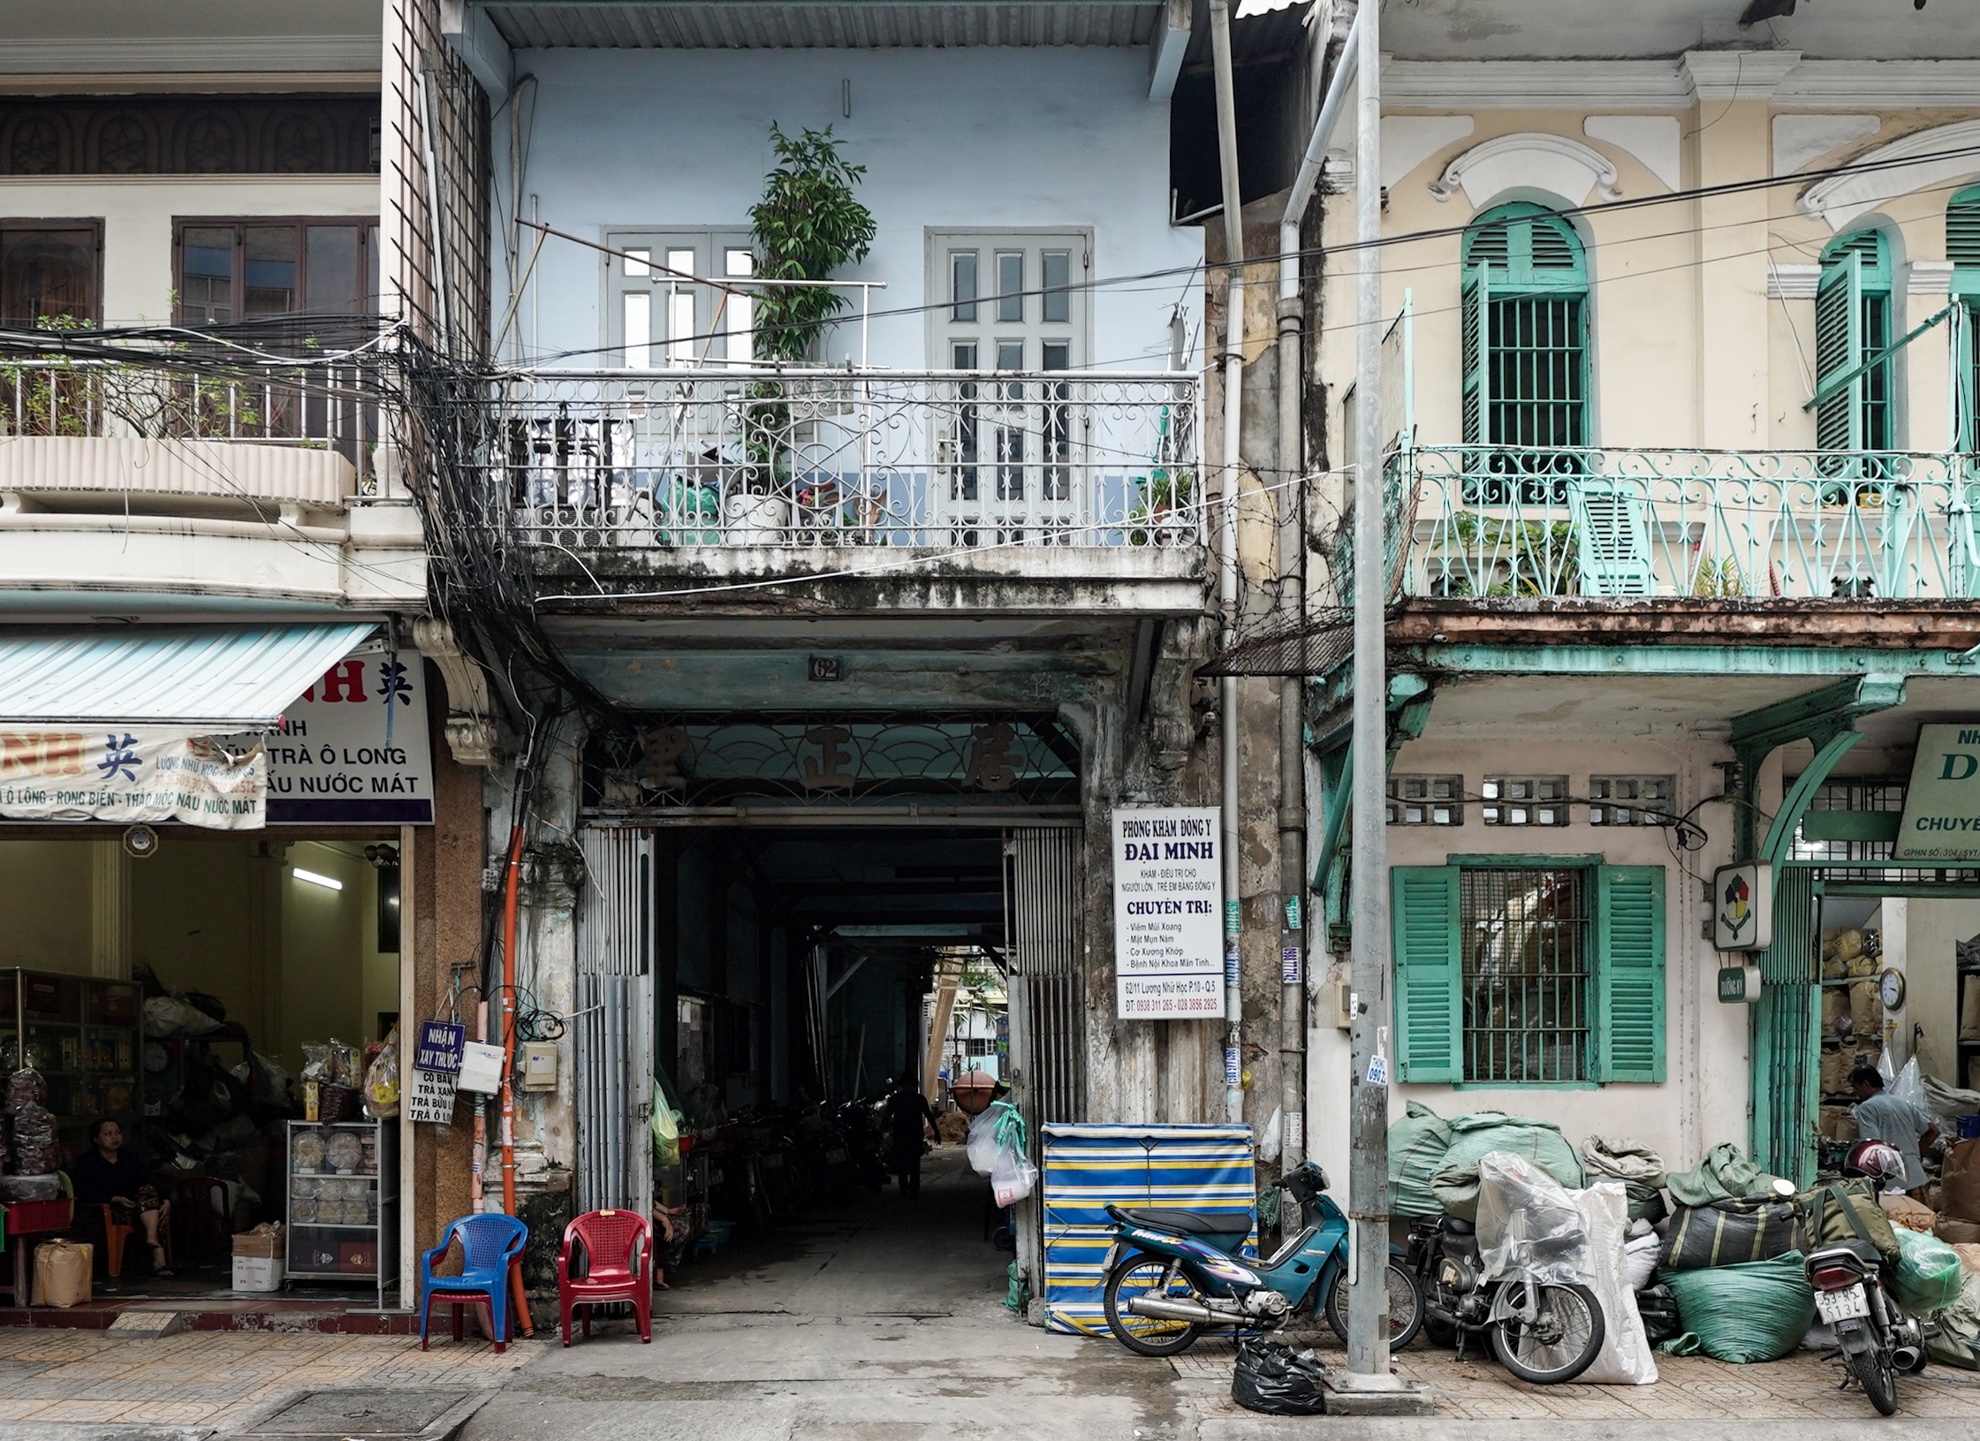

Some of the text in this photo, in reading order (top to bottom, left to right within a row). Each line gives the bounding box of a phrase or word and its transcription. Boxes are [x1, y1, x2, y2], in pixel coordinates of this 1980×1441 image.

[813, 659, 838, 678] 62
[377, 661, 413, 706] 英
[97, 733, 143, 782] 英
[267, 744, 313, 764] TRÀ
[320, 744, 336, 765] Ô
[344, 748, 407, 765] LONG
[300, 772, 364, 793] NƯỚC
[372, 772, 419, 793] MÁT
[176, 790, 200, 811] NẤU
[232, 795, 257, 815] MÁT
[1205, 819, 1212, 837] Y
[1125, 841, 1214, 865] ĐẠI MINH
[1184, 868, 1197, 878] CHO
[1168, 881, 1177, 891] EM
[1127, 897, 1182, 915] CHUYÊN
[1161, 922, 1183, 933] Xoang
[1161, 959, 1179, 968] Khoa
[428, 1026, 456, 1048] NHẬN
[419, 1049, 435, 1066] XAY
[418, 1083, 436, 1095] TRÀ
[411, 1096, 430, 1108] TRÀ
[410, 1109, 431, 1122] TRÀ
[433, 1109, 441, 1121] Ô
